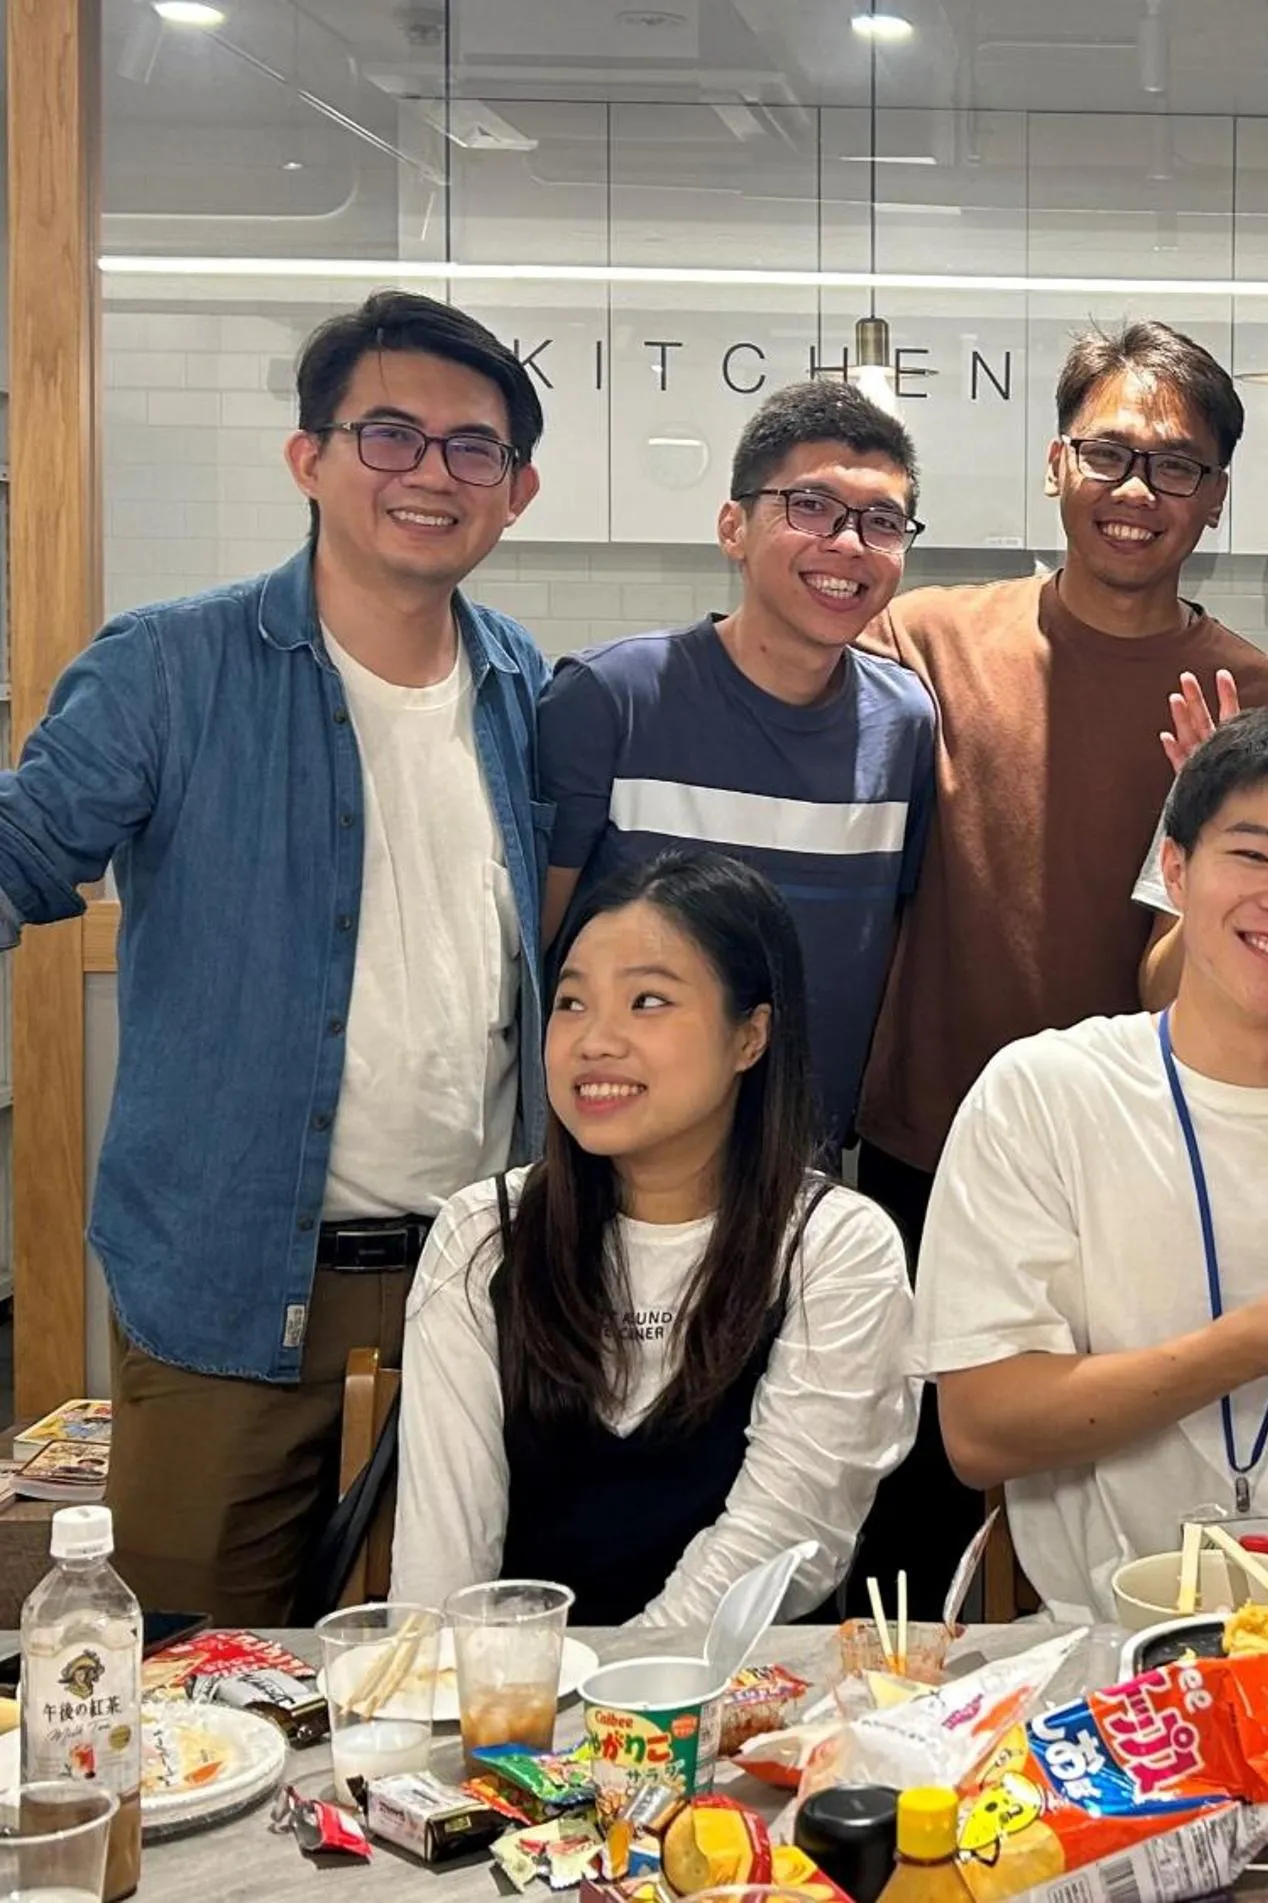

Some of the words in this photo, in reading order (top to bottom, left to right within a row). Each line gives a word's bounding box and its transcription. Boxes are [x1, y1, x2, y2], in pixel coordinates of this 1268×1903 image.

[512, 338, 1011, 400] KITCHEN
[43, 1696, 121, 1722] 午後の紅茶
[595, 1710, 634, 1728] Calbee
